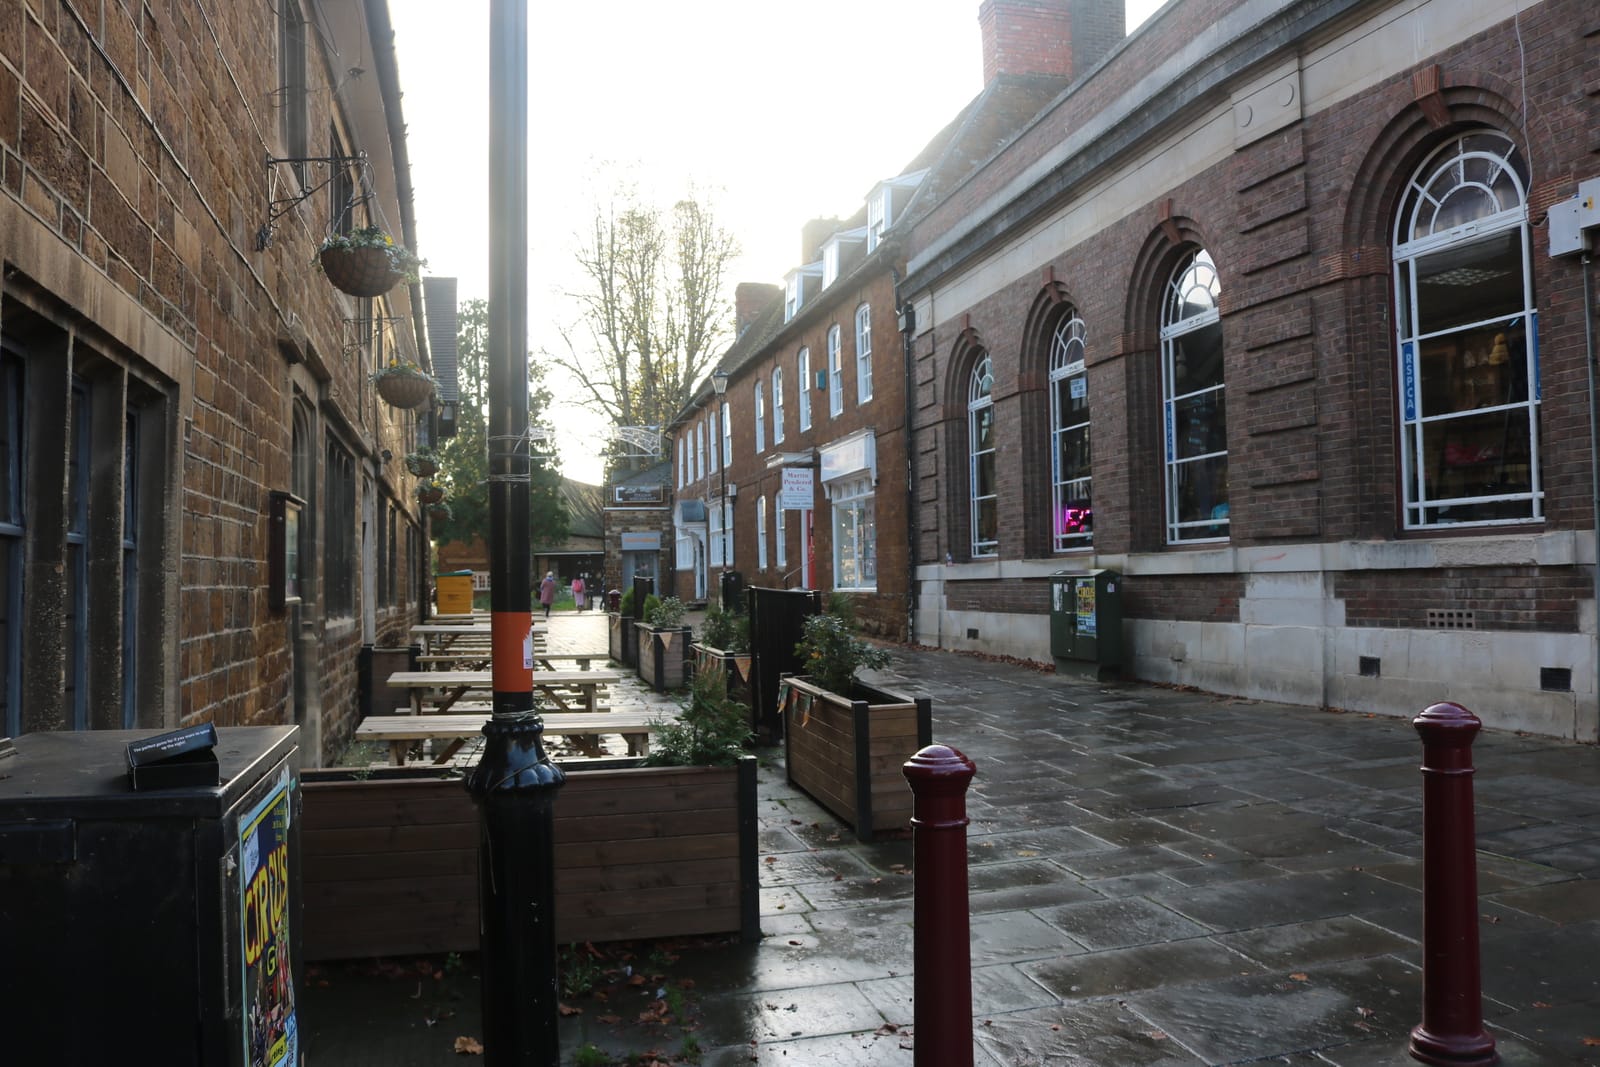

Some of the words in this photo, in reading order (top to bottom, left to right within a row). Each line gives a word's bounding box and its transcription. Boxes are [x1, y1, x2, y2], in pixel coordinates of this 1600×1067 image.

[1405, 353, 1414, 409] RSPCA
[141, 744, 156, 752] perfect
[244, 842, 288, 965] CIRCUS
